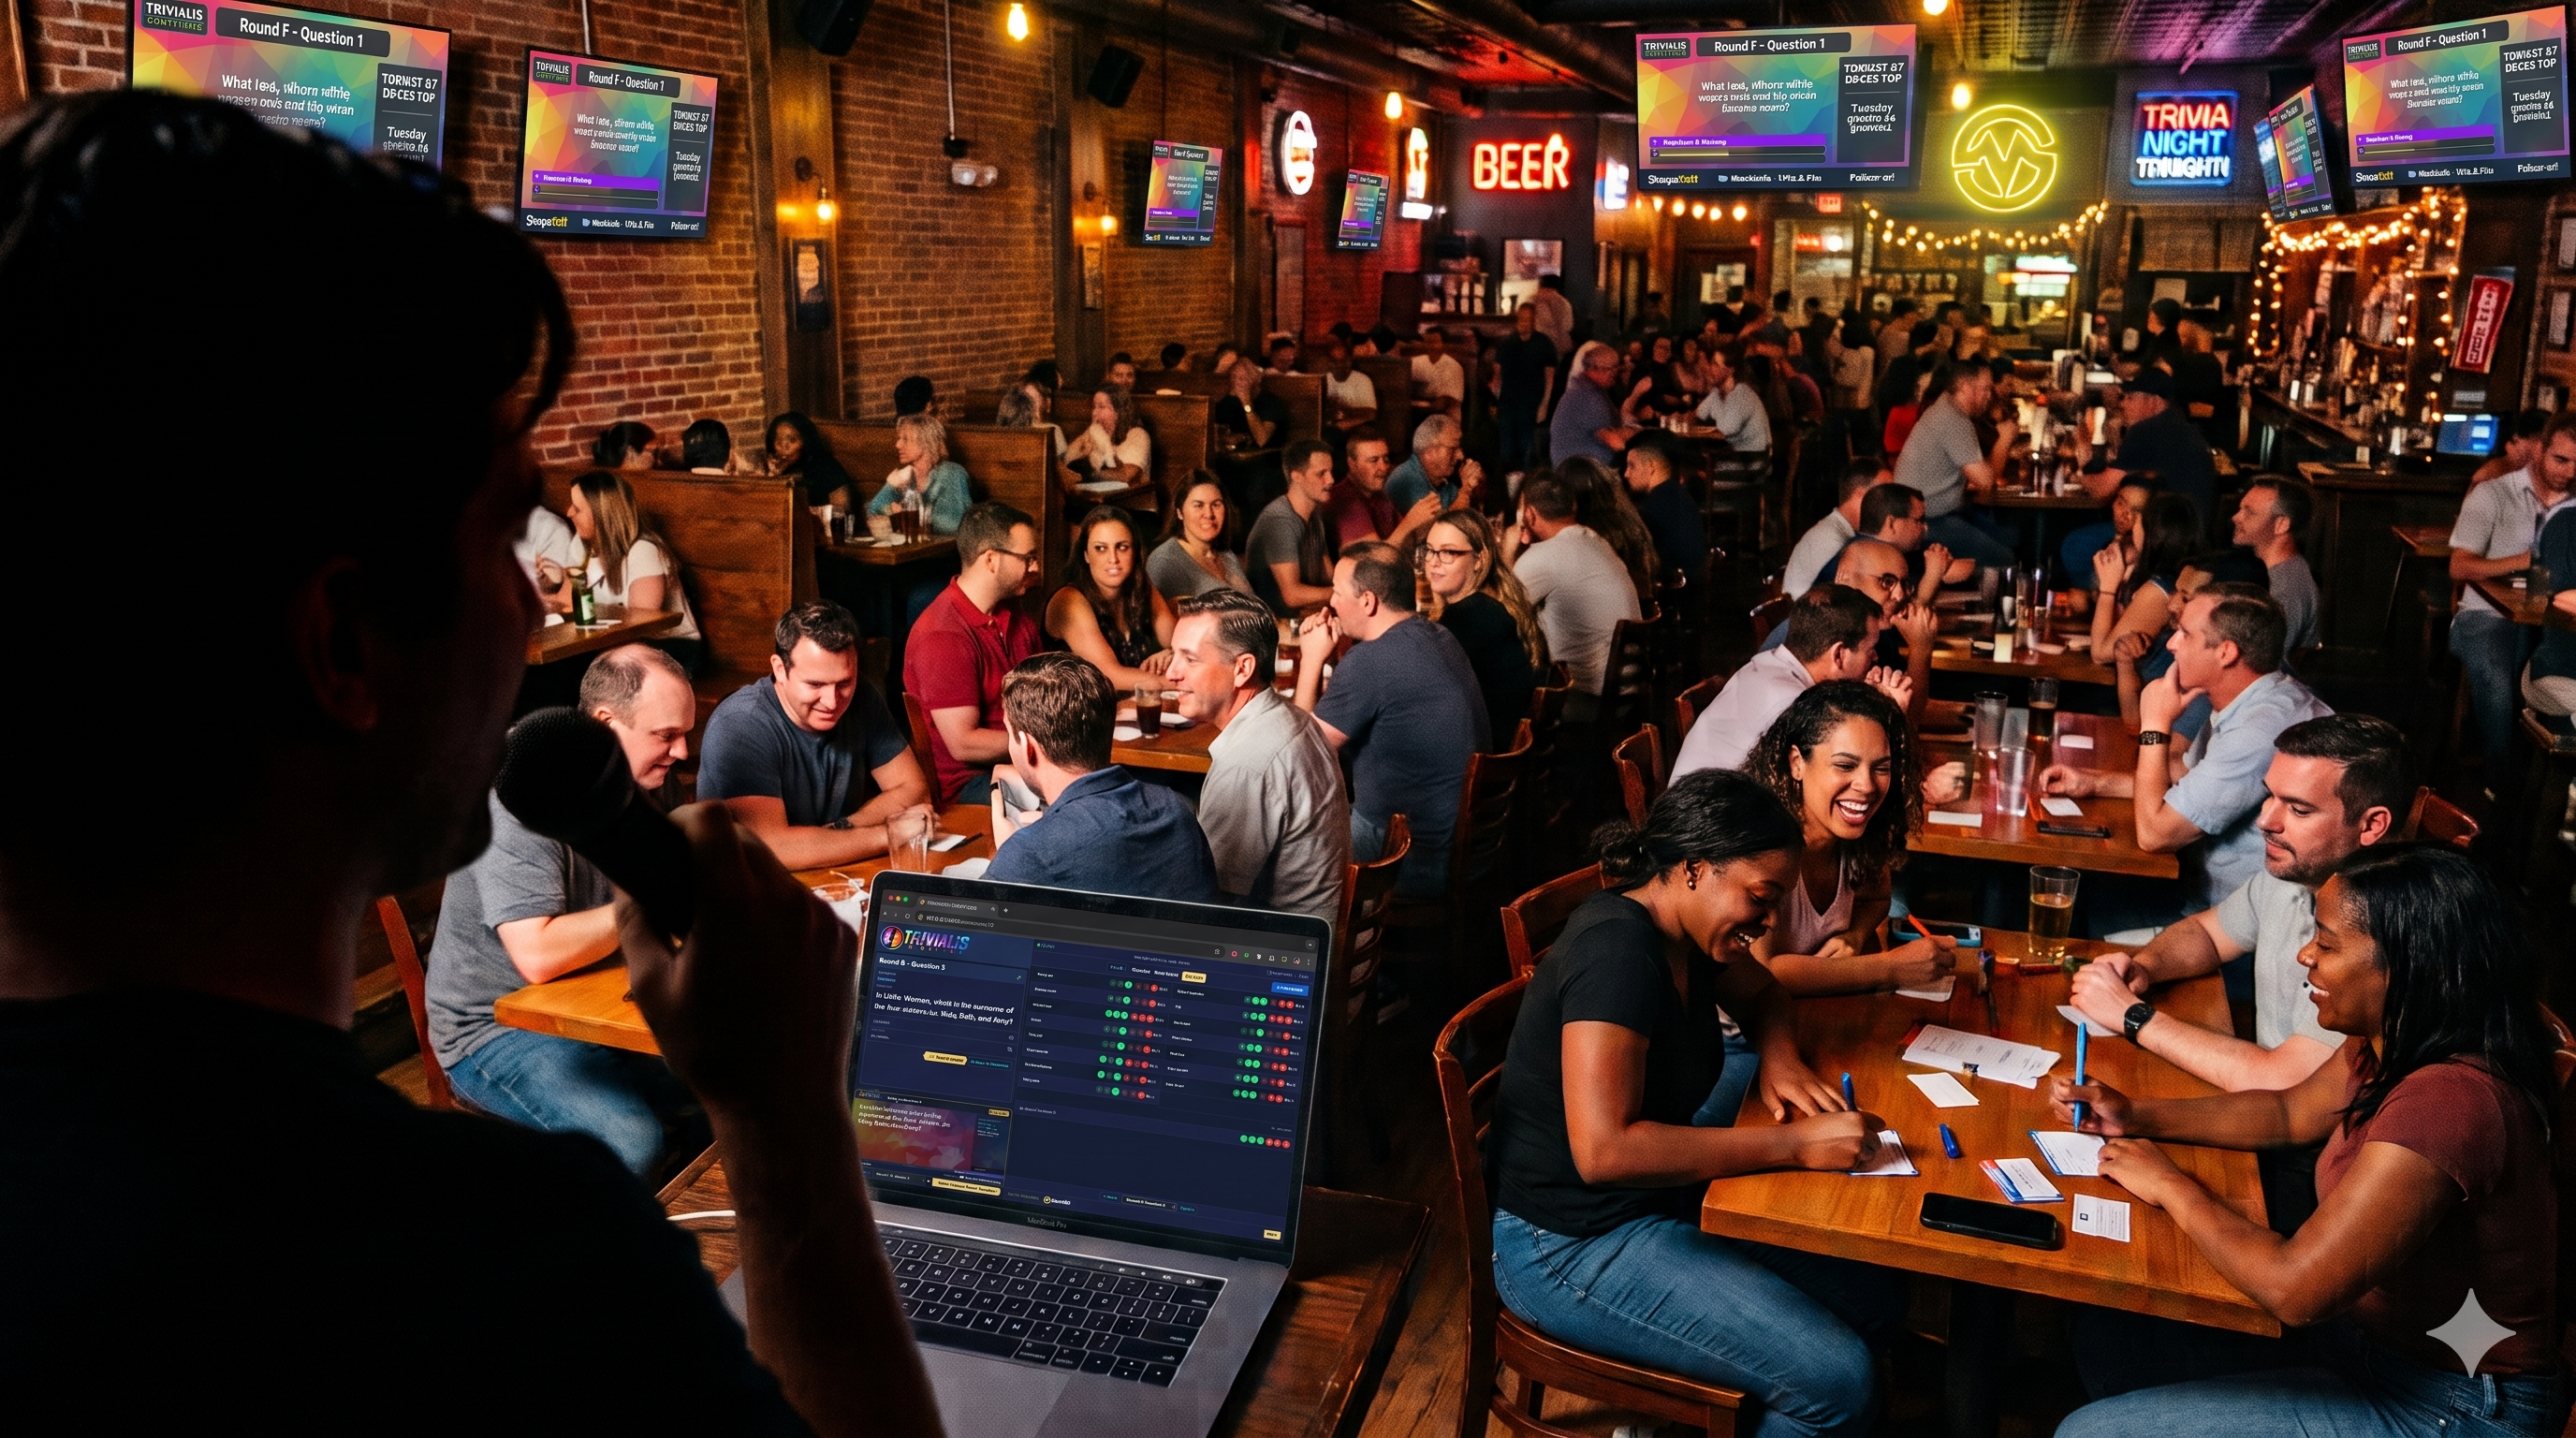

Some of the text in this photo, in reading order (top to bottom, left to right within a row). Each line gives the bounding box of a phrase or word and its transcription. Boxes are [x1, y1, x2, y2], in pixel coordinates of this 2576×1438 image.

[146, 2, 203, 21] TRIVIALIS
[240, 18, 280, 37] Round
[282, 22, 290, 37] F
[300, 27, 355, 47] Question
[357, 34, 364, 48] 1
[2398, 35, 2424, 51] Round
[2425, 35, 2432, 46] F
[2438, 31, 2480, 47] Question
[2481, 28, 2487, 39] 1
[1644, 42, 1687, 51] TRIVIALIS
[1715, 40, 1749, 52] Round
[1750, 41, 1757, 51] F
[1767, 38, 1817, 51] Question
[1820, 38, 1825, 49] 1
[2538, 58, 2557, 70] TOP
[222, 74, 252, 92] What
[589, 71, 613, 85] Round
[615, 75, 620, 85] F
[1881, 73, 1902, 83] TOP
[2391, 78, 2408, 89] What
[1702, 81, 1724, 91] What
[417, 92, 436, 103] TOP
[2143, 103, 2231, 129] TRIVIA
[387, 126, 427, 142] Tuesday
[2143, 128, 2227, 155] NIGHT
[1473, 140, 1571, 190] BEER
